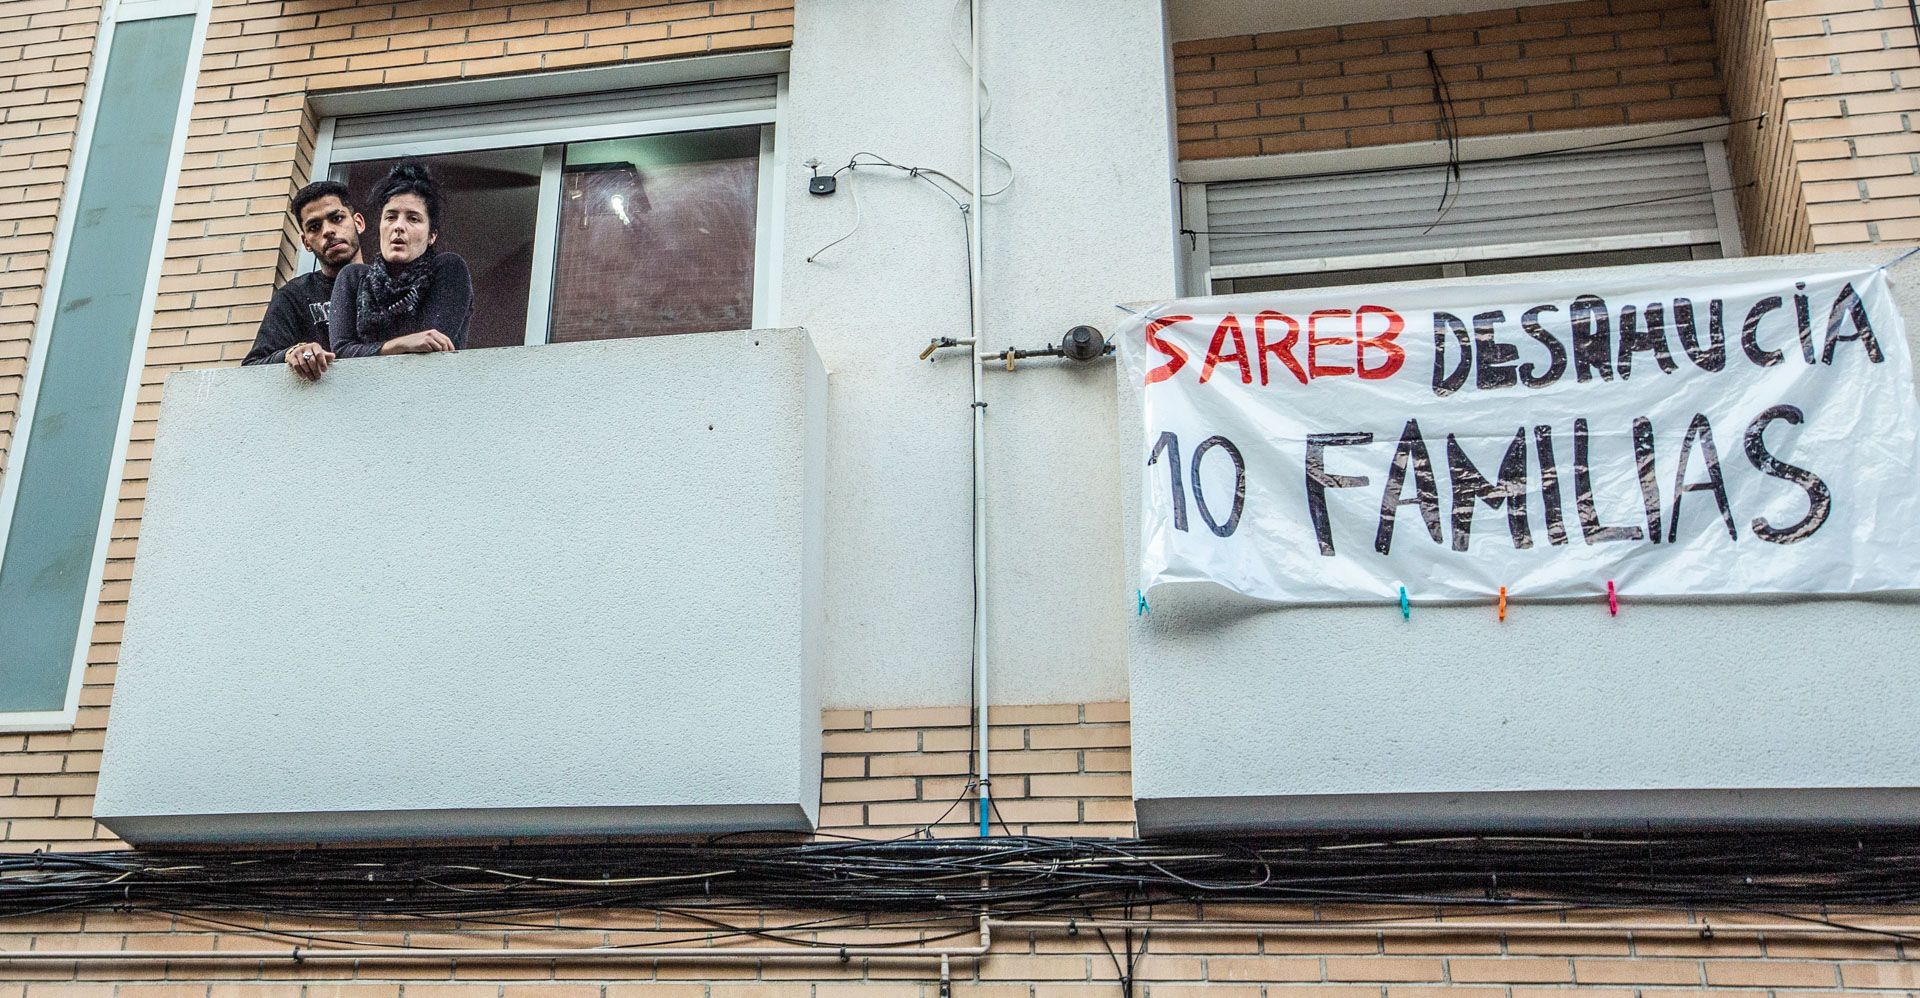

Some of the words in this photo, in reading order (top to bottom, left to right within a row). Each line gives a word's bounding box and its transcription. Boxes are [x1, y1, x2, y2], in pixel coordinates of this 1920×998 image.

[1144, 305, 1406, 386] SAREB
[1147, 431, 1246, 538] 10
[1305, 404, 1832, 557] FAMILIAS
